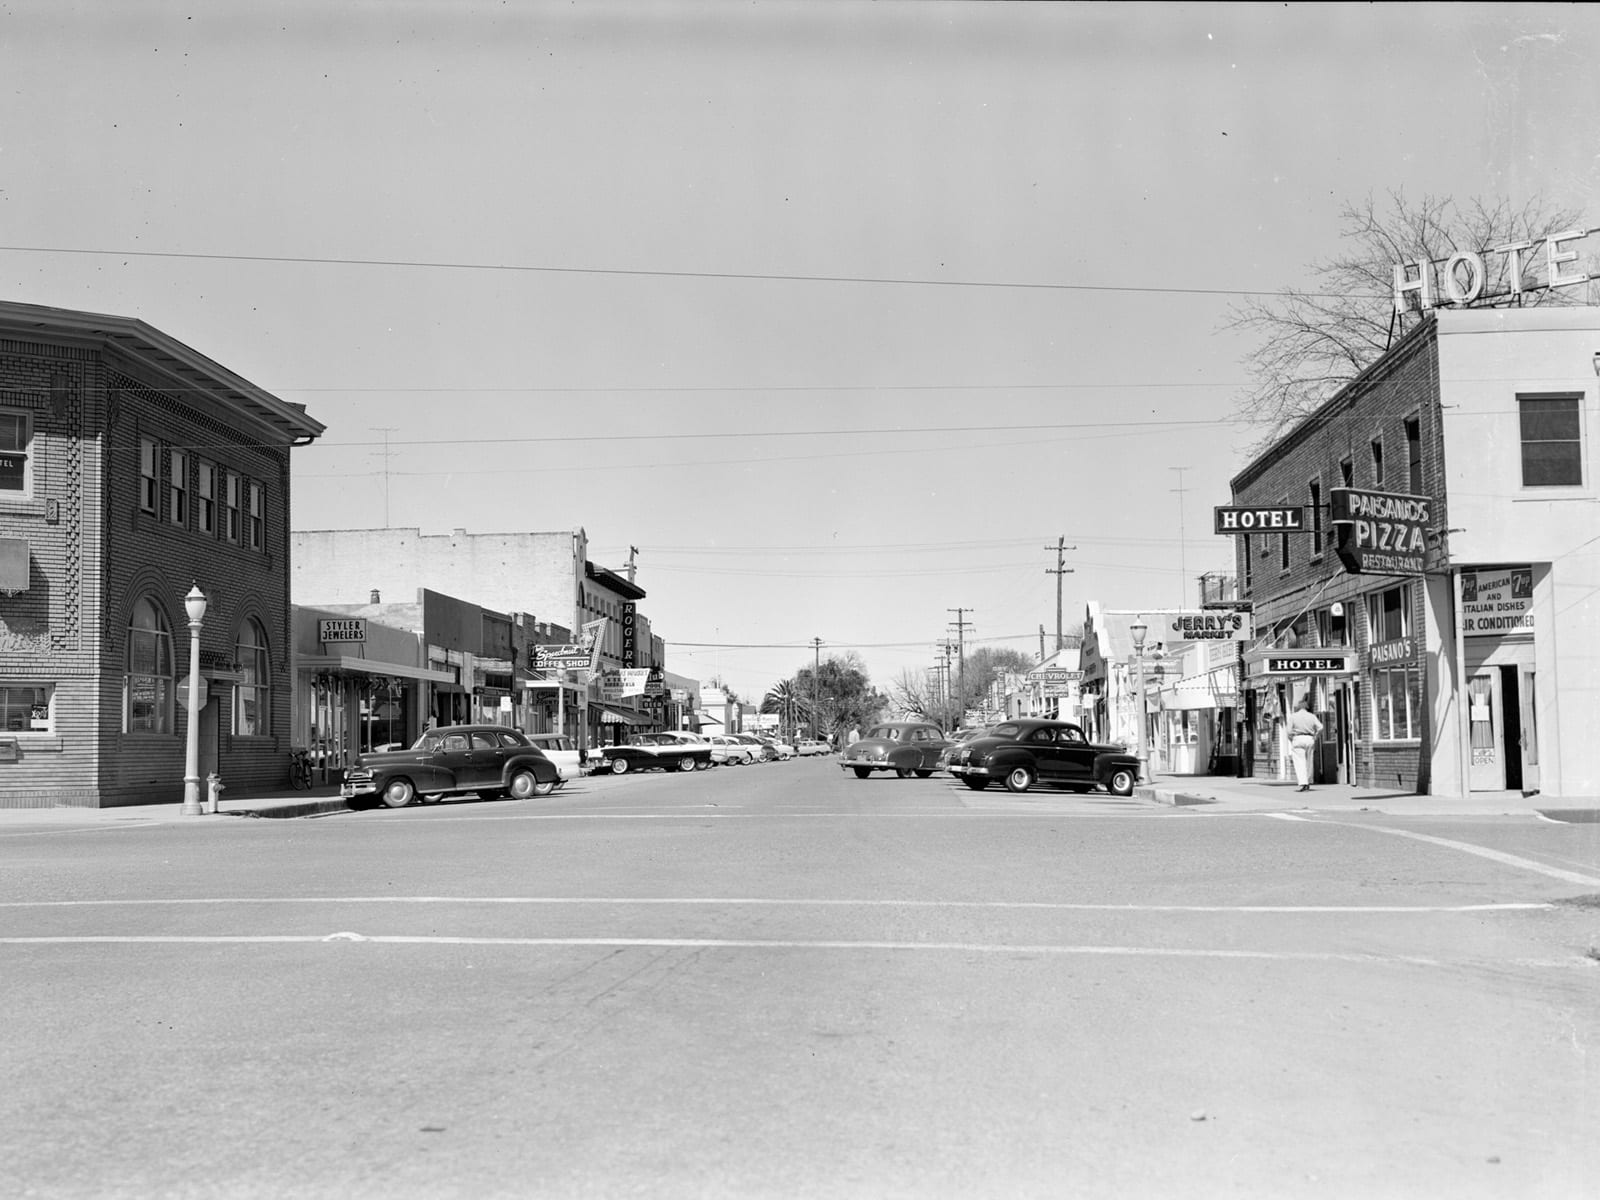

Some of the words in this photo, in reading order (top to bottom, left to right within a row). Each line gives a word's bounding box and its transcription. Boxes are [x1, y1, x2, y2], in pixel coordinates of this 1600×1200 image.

[1222, 510, 1299, 528] HOTEL
[1355, 519, 1426, 553] PIZZA
[1362, 553, 1424, 571] RESTAURANT
[1478, 577, 1511, 592] AMERICAN
[1486, 592, 1502, 601] AND
[1463, 603, 1494, 613] ITALIAN
[1497, 601, 1525, 611] DISHES
[326, 621, 361, 631] STYLER
[1172, 613, 1243, 632] JERRY'S
[1462, 618, 1475, 631] IR
[1477, 615, 1535, 630] CONDITIONED
[322, 630, 364, 640] JEWELERS
[623, 604, 633, 669] ROGERS
[1183, 630, 1235, 640] MARKET
[1371, 639, 1411, 664] PAISANO'S
[532, 660, 564, 668] COFFE
[566, 660, 590, 668] SHOP
[1276, 659, 1338, 670] HOTEL
